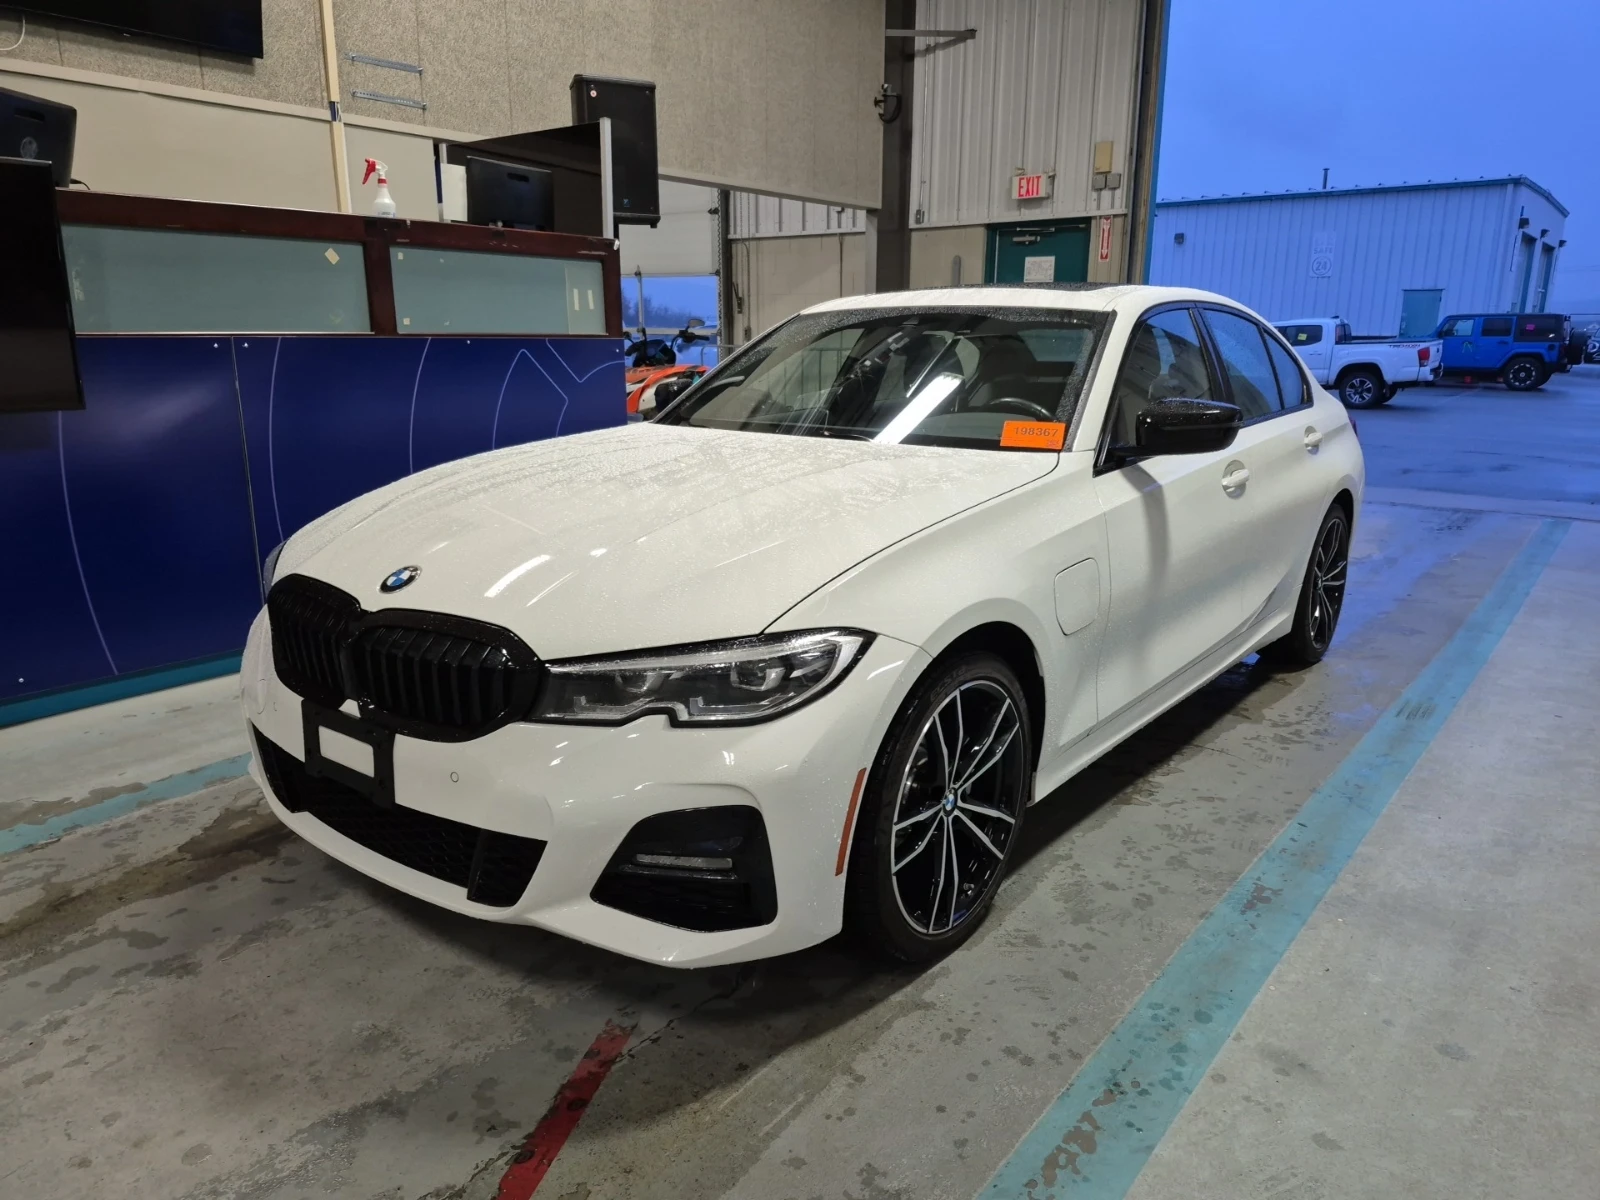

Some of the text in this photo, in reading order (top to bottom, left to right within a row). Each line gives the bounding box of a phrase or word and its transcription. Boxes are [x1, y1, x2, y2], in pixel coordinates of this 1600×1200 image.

[1018, 175, 1042, 198] EXIT
[1315, 260, 1328, 272] 24
[1013, 427, 1059, 437] 198367
